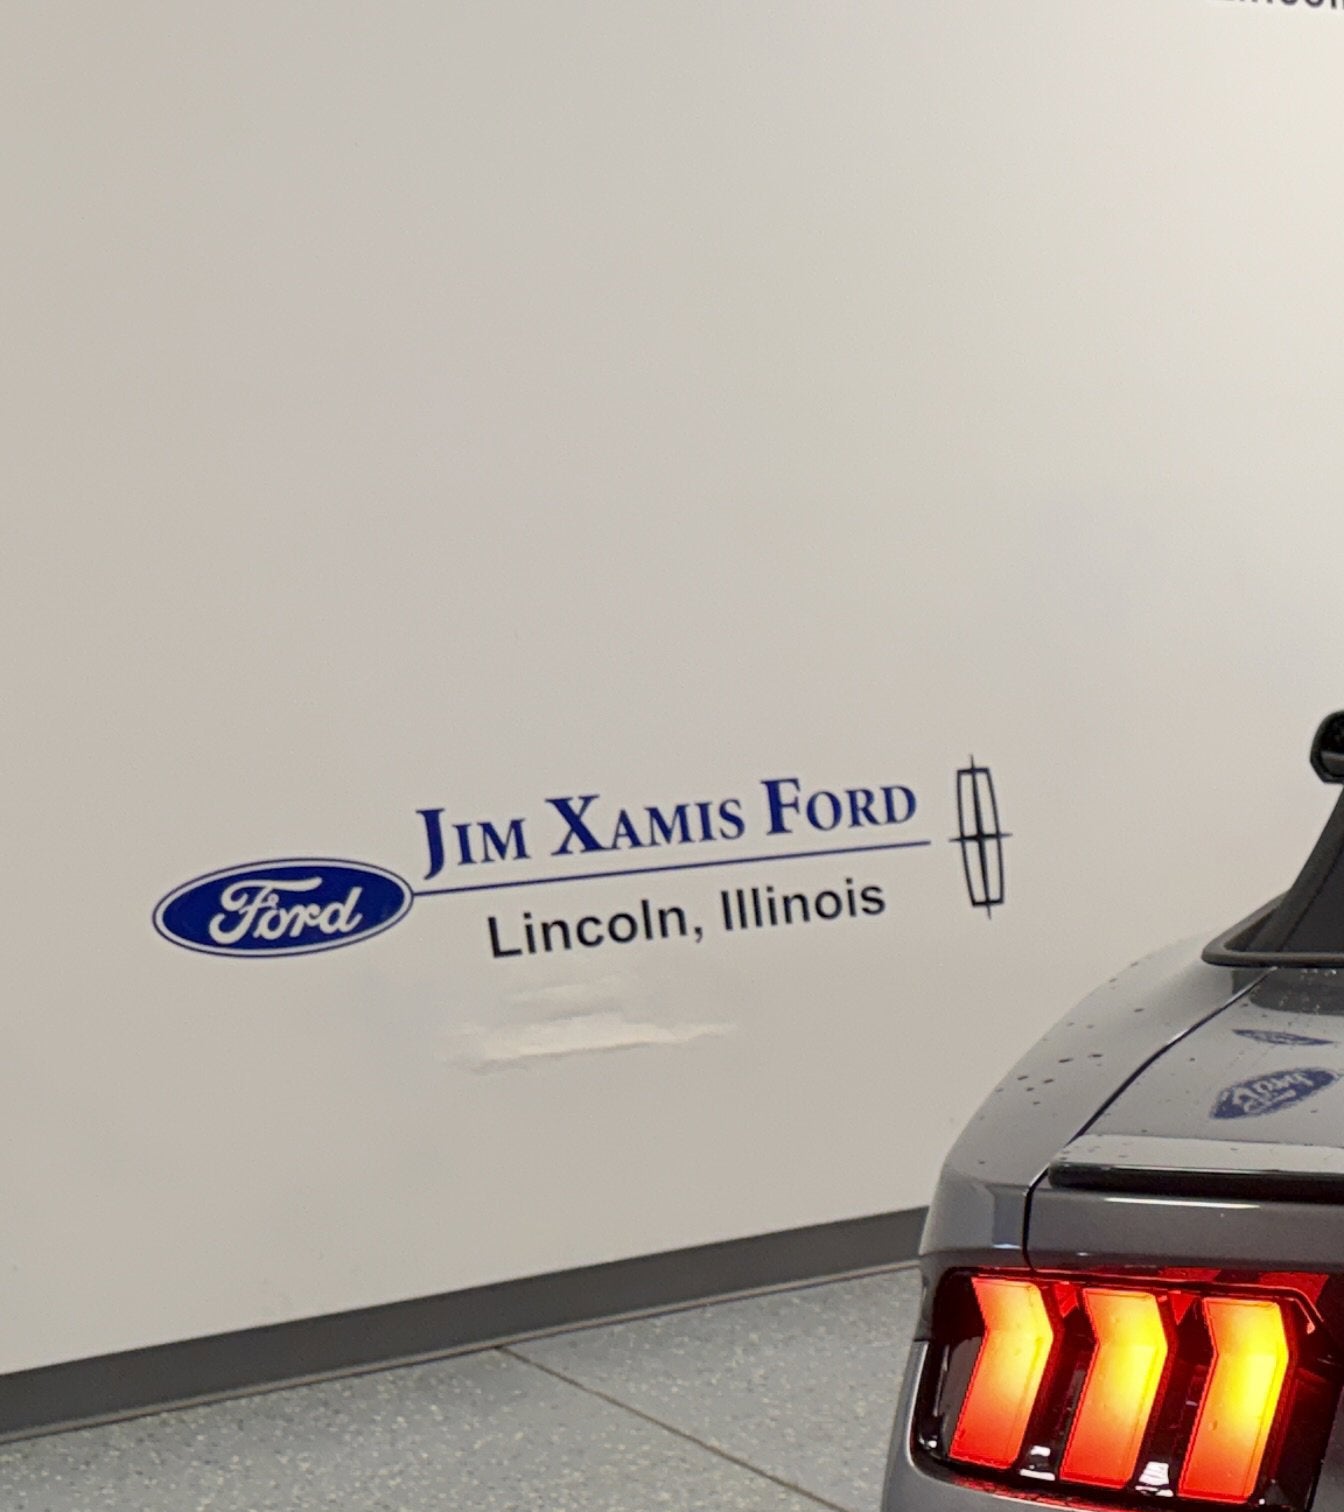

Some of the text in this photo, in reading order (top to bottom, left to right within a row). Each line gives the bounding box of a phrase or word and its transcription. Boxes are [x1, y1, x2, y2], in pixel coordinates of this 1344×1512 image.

[415, 777, 917, 880] JIM XAMIS FORD
[208, 876, 362, 945] Ford
[487, 878, 886, 959] Lincoln, Illinois
